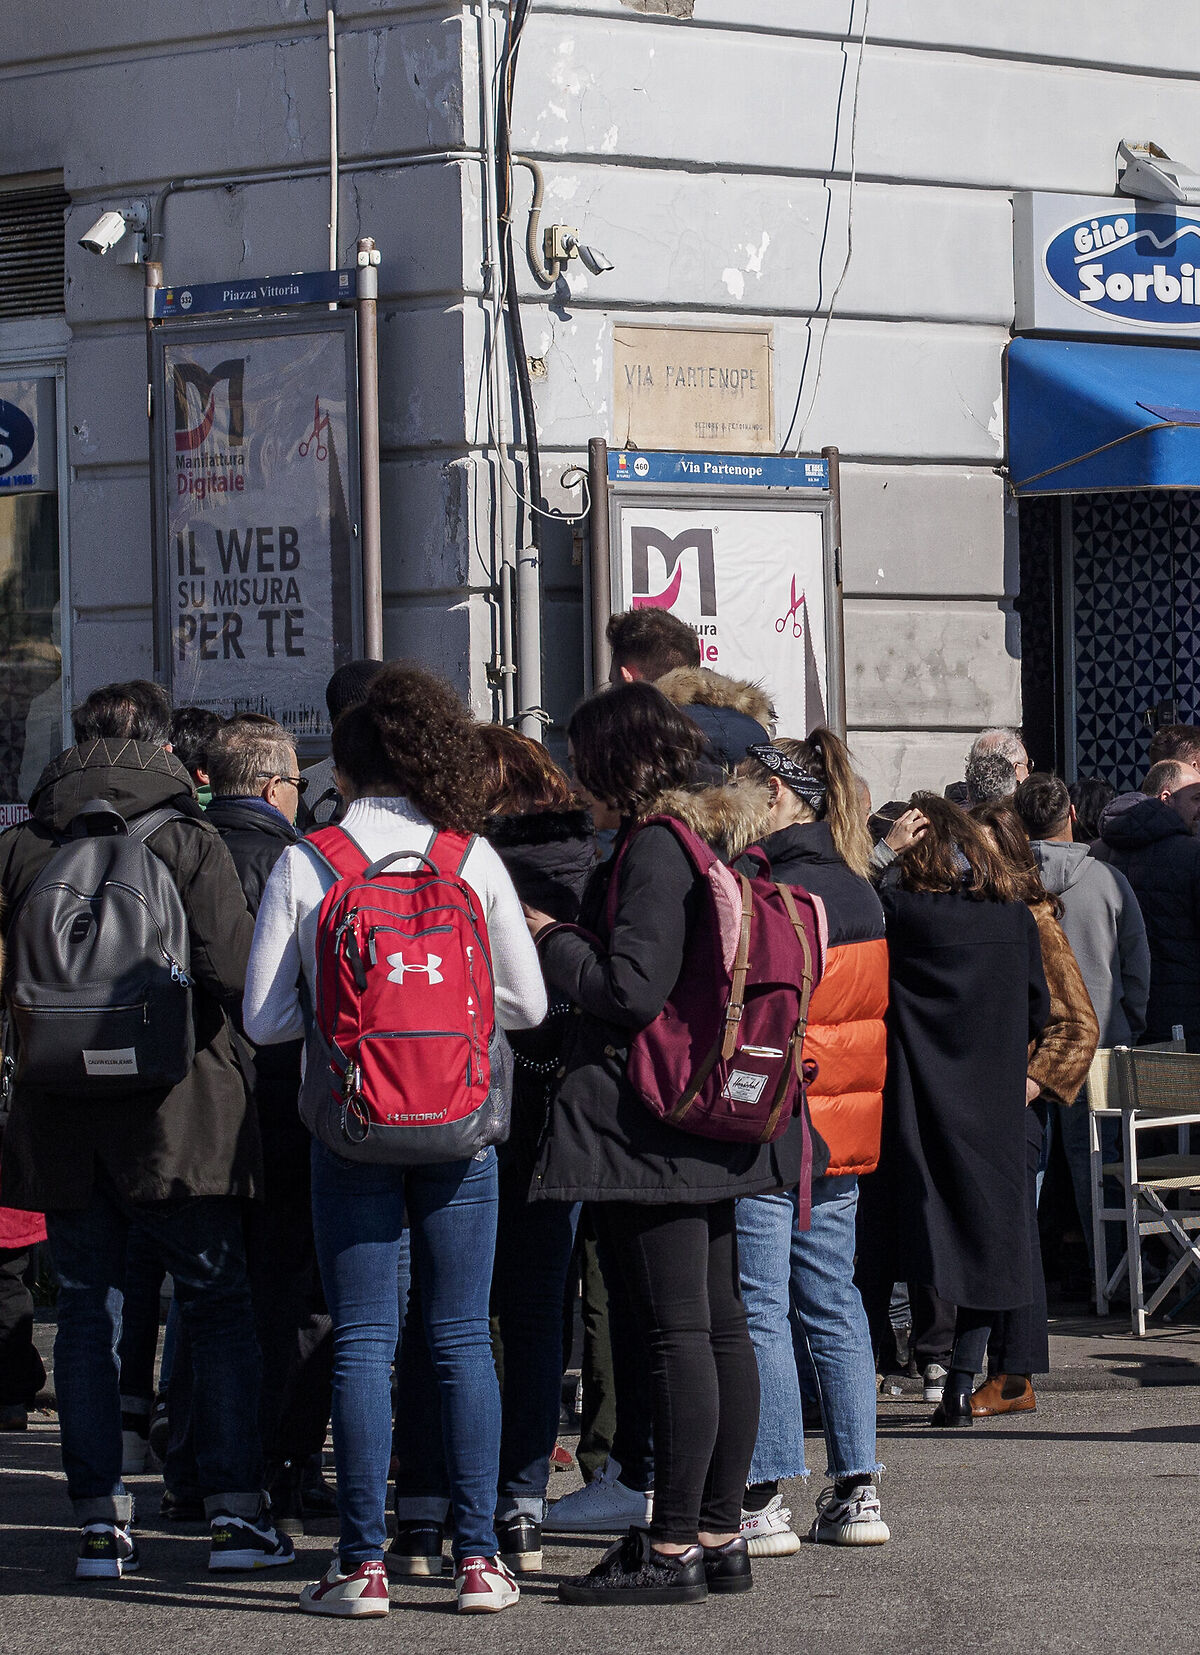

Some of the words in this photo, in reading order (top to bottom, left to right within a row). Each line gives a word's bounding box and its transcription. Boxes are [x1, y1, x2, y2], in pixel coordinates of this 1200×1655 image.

[1074, 217, 1129, 254] Gino
[223, 288, 257, 302] Piazza
[259, 282, 300, 299] Vittoria
[624, 364, 654, 386] VIA
[666, 365, 759, 390] PARTENOPE
[176, 452, 245, 469] Manifattura
[635, 463, 648, 471] 460
[681, 460, 701, 474] Via
[703, 462, 763, 478] Partenope
[177, 469, 245, 499] Digitale
[177, 530, 205, 576] IL
[216, 526, 300, 574] WEB
[178, 580, 206, 608] SU
[213, 576, 301, 607] MISURA
[178, 612, 245, 661] PER
[258, 609, 305, 657] TE
